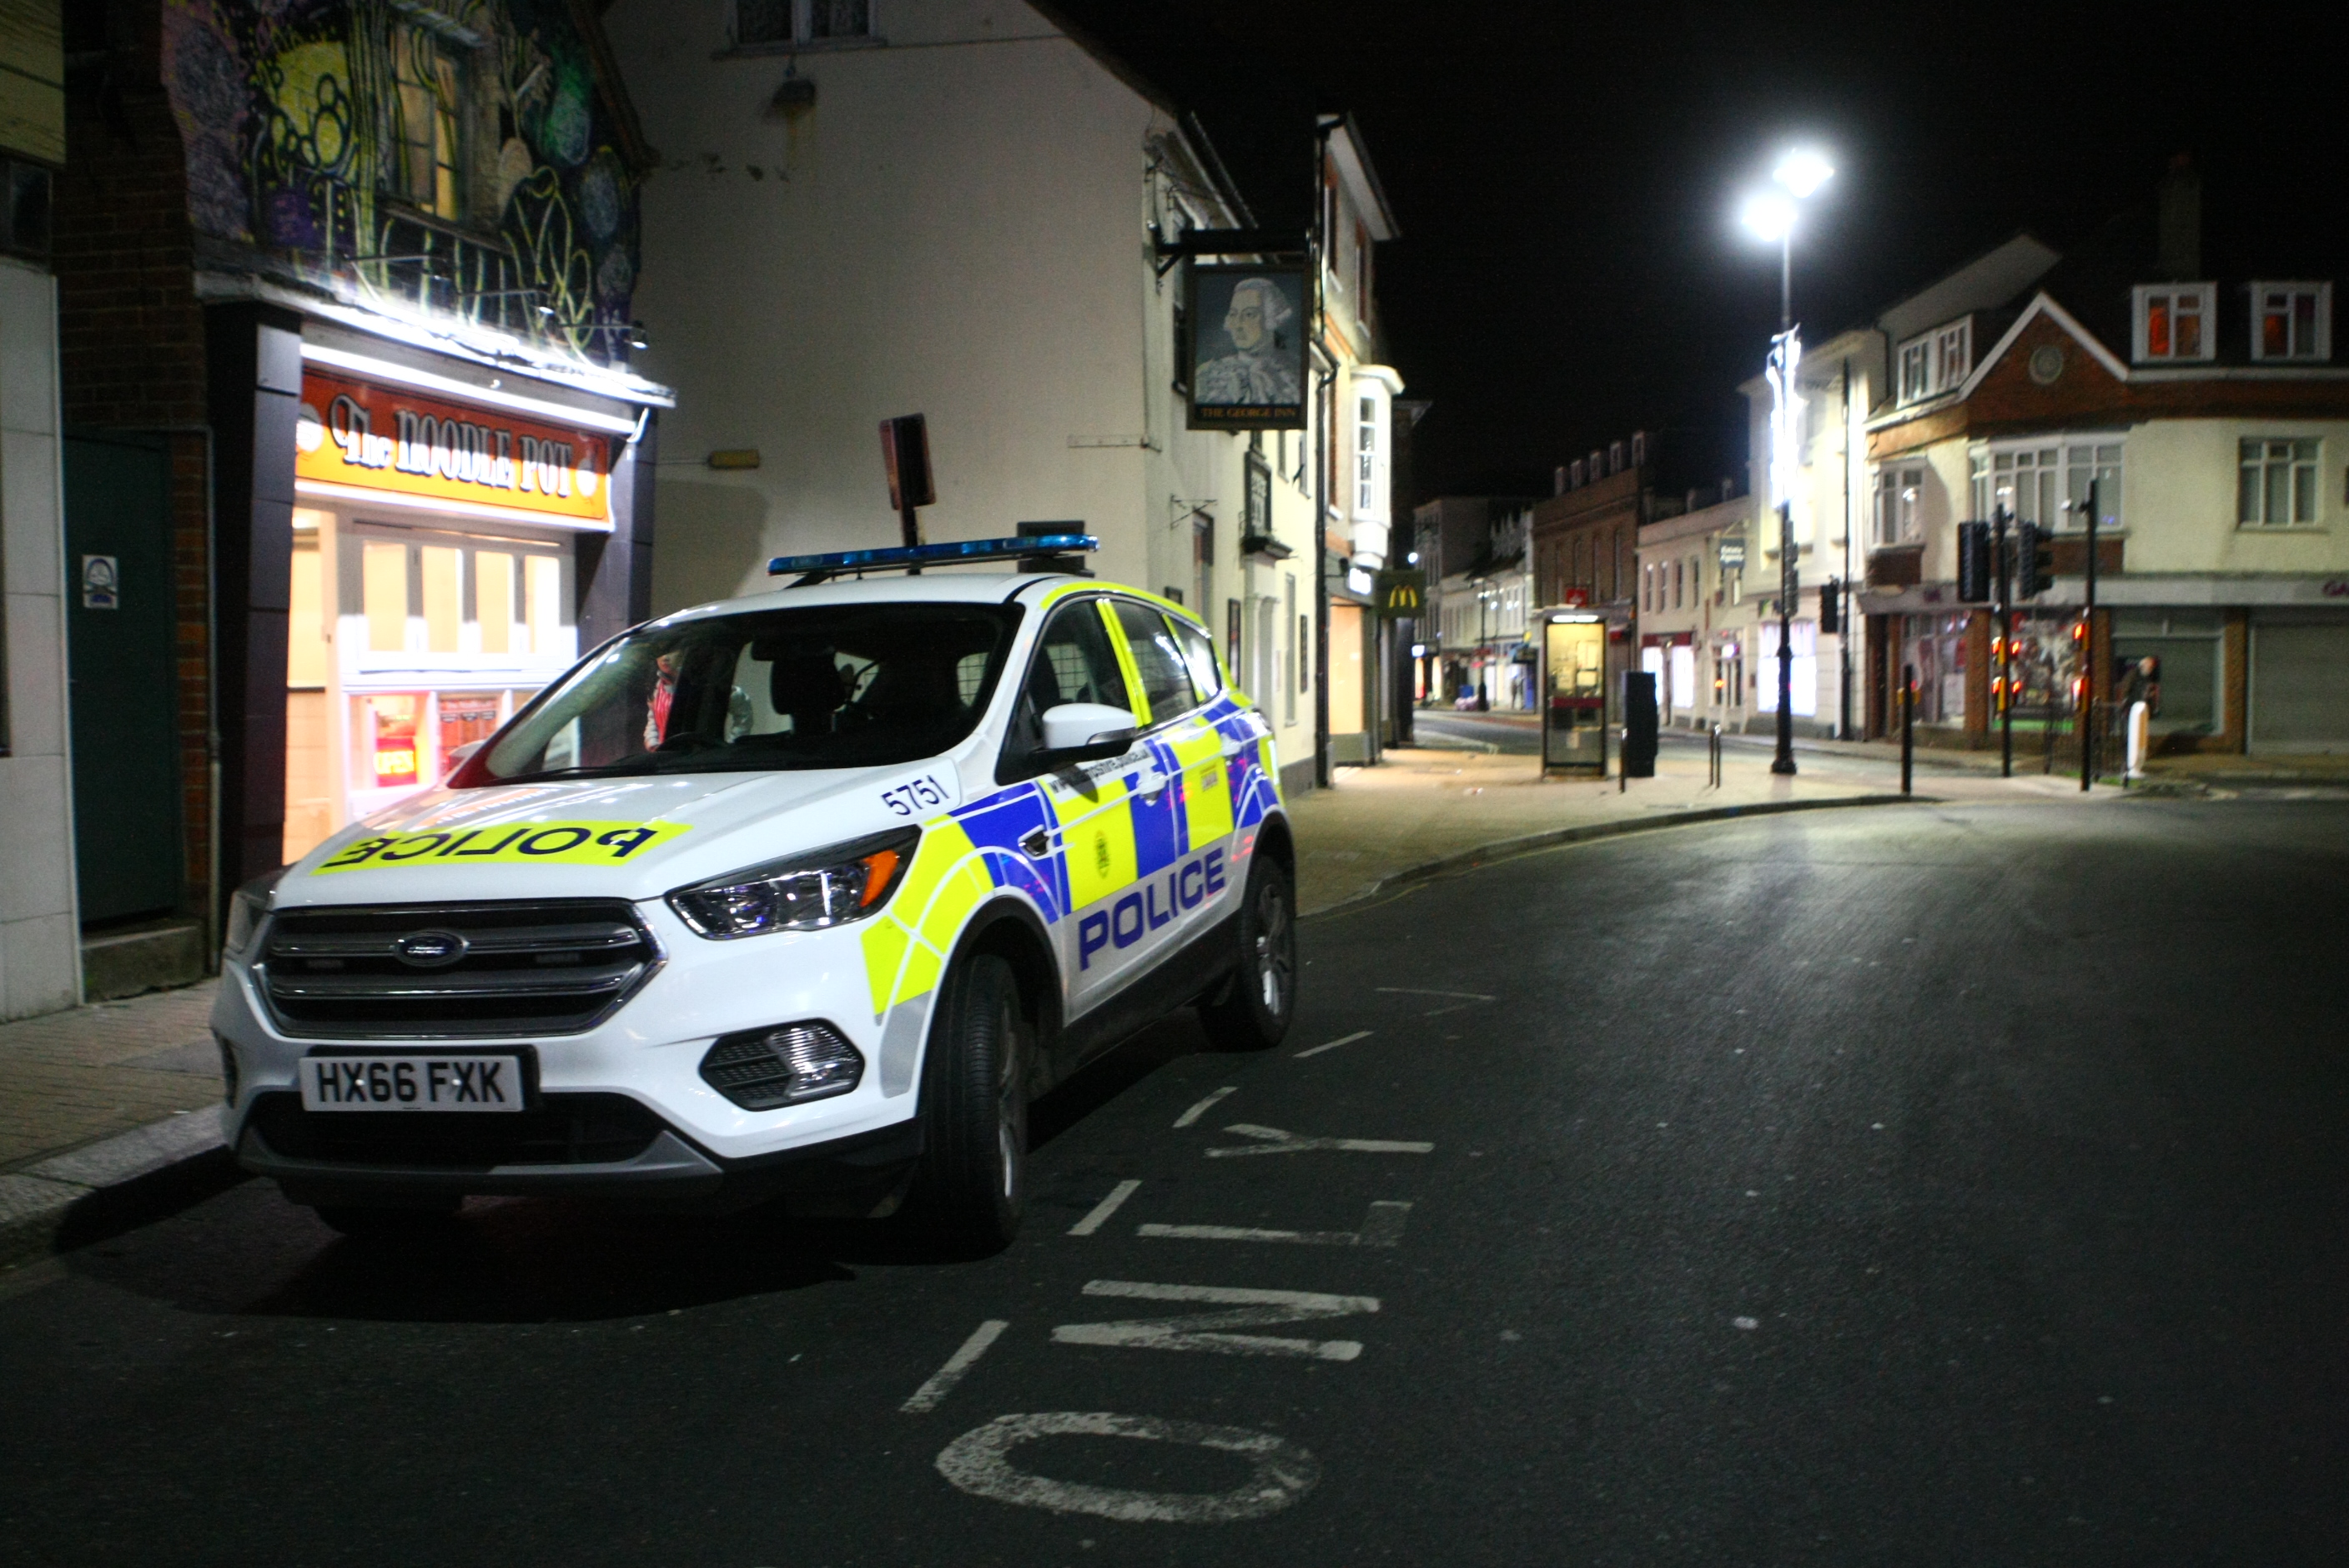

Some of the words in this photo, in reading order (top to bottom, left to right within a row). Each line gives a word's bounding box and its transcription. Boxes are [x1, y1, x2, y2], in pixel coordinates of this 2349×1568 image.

[329, 393, 392, 470] The
[518, 435, 574, 498] POT
[880, 775, 950, 816] 5751
[1078, 846, 1225, 972] POLICE
[316, 1062, 417, 1103] HX66
[426, 1062, 506, 1103] FXK
[933, 1123, 1436, 1523] ONLY
